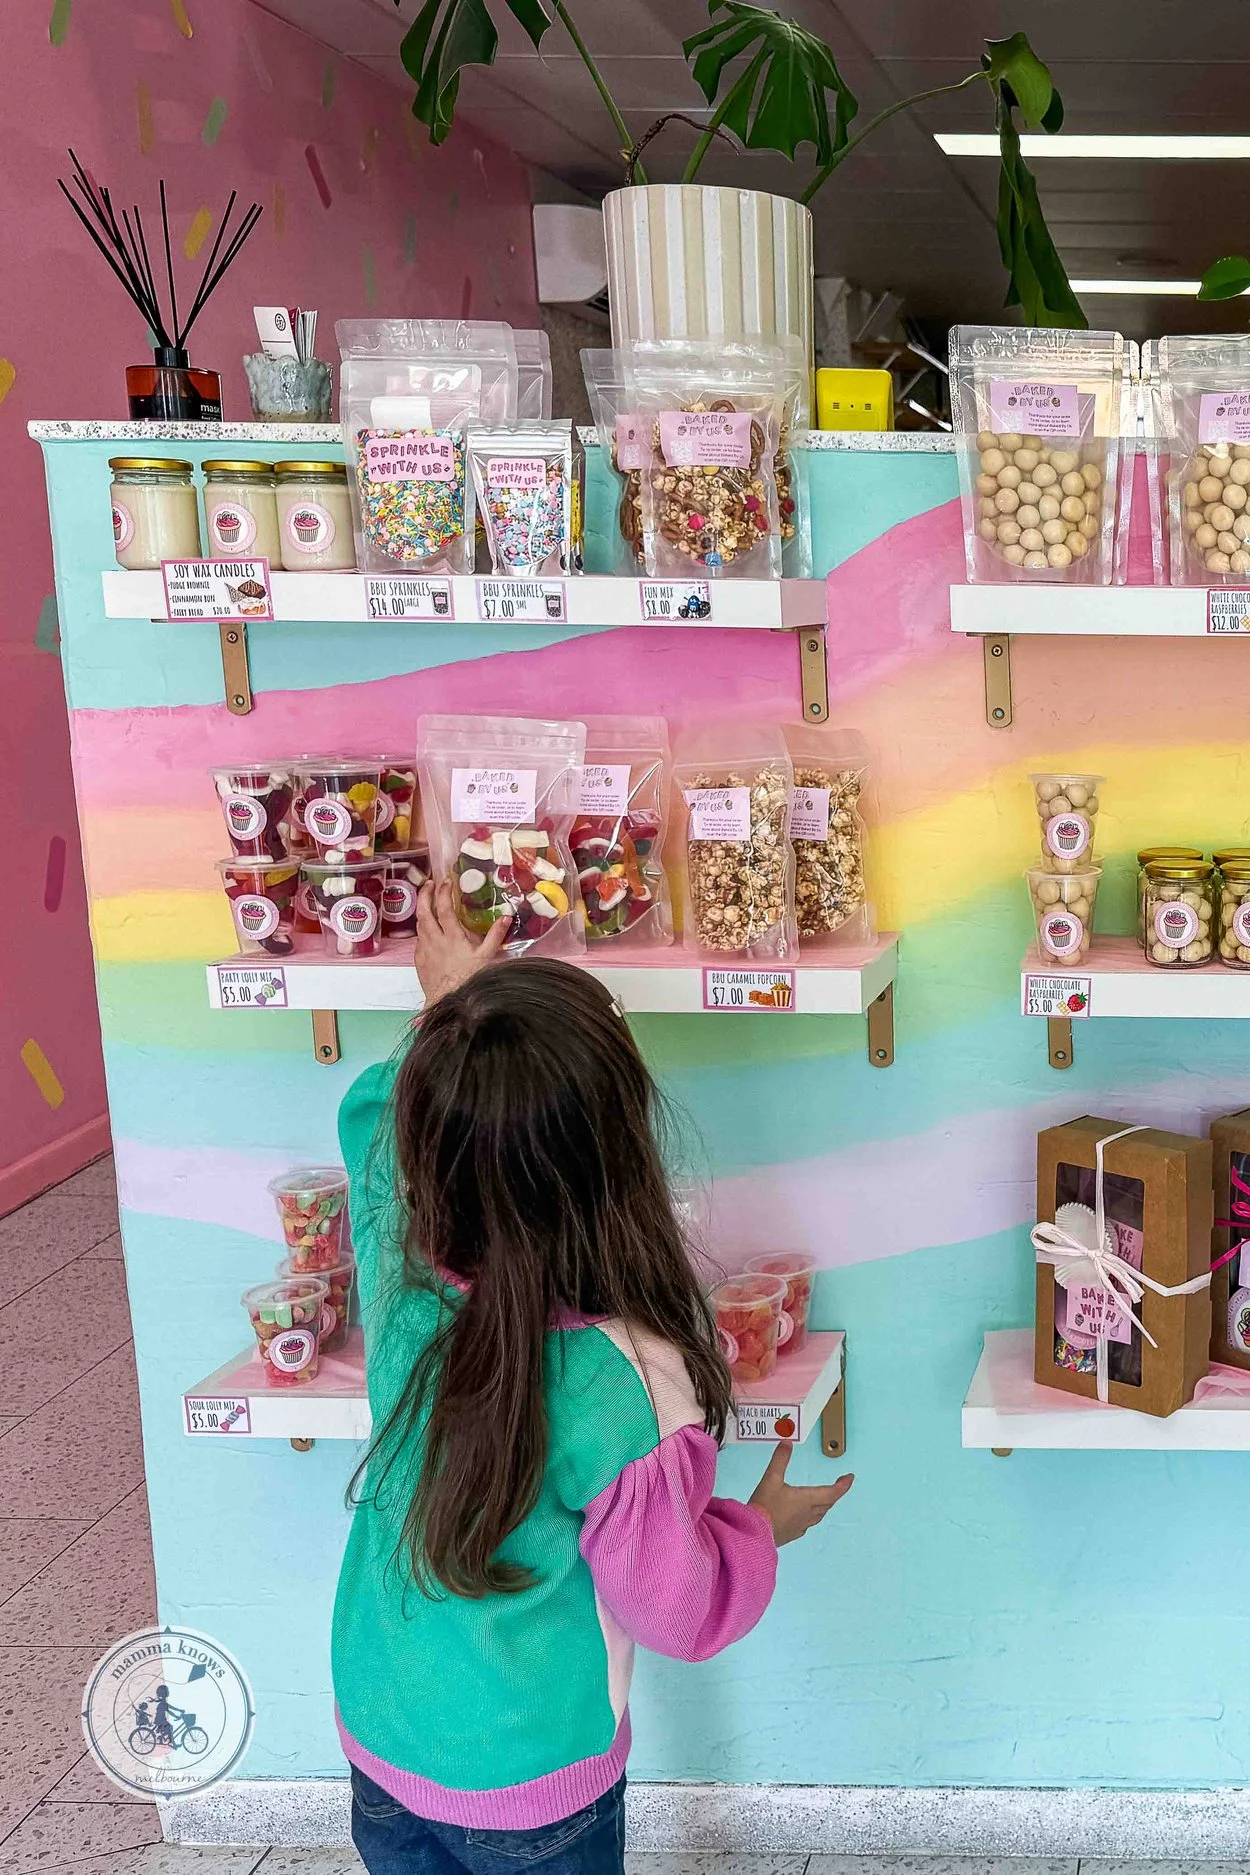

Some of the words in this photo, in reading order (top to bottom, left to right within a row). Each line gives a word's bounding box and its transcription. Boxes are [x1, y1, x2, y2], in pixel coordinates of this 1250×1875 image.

[370, 442, 449, 458] SPRINKLE
[378, 460, 417, 475] WITH
[421, 462, 442, 476] US
[490, 461, 543, 473] SPRINKLE
[495, 474, 522, 485] WITH
[525, 475, 538, 485] US
[174, 564, 189, 578] SOY
[192, 564, 211, 578] WAX
[214, 563, 255, 578] CANDLES
[370, 582, 387, 596] BBU
[389, 582, 431, 597] SPRINKLES
[483, 583, 499, 597] BBU
[503, 584, 544, 598] SPRINKLES
[644, 586, 658, 599] FUN
[660, 586, 674, 598] MIX
[1211, 593, 1230, 603] WHITE
[212, 606, 231, 615] $20.00
[369, 597, 405, 618] $14.00
[484, 599, 515, 619] $7.00
[646, 600, 671, 616] $8.00
[1211, 604, 1247, 614] RASPBERRIES
[1211, 615, 1240, 631] $12.00
[221, 972, 239, 983] PARTY
[241, 972, 258, 983] LOLLY
[259, 972, 272, 982] MIX
[712, 972, 725, 984] BBU
[726, 973, 756, 984] CARAMEL
[757, 974, 786, 985] POPCORN
[1030, 979, 1048, 989] WHITE
[1049, 979, 1081, 990] CHOCOLATE
[223, 986, 251, 1004] $5.00
[712, 987, 743, 1006] $7.00
[1029, 989, 1064, 1000] RASPBERRIES
[1029, 999, 1052, 1013] $5.00
[1081, 1287, 1115, 1306] BAKE
[1080, 1303, 1117, 1323] WITH
[189, 1401, 205, 1410] SOUR
[206, 1401, 222, 1410] LOLLY
[224, 1401, 235, 1410] MIX
[760, 1407, 781, 1418] HEARTS
[191, 1413, 219, 1429] $5.00
[739, 1420, 767, 1436] $5.00
